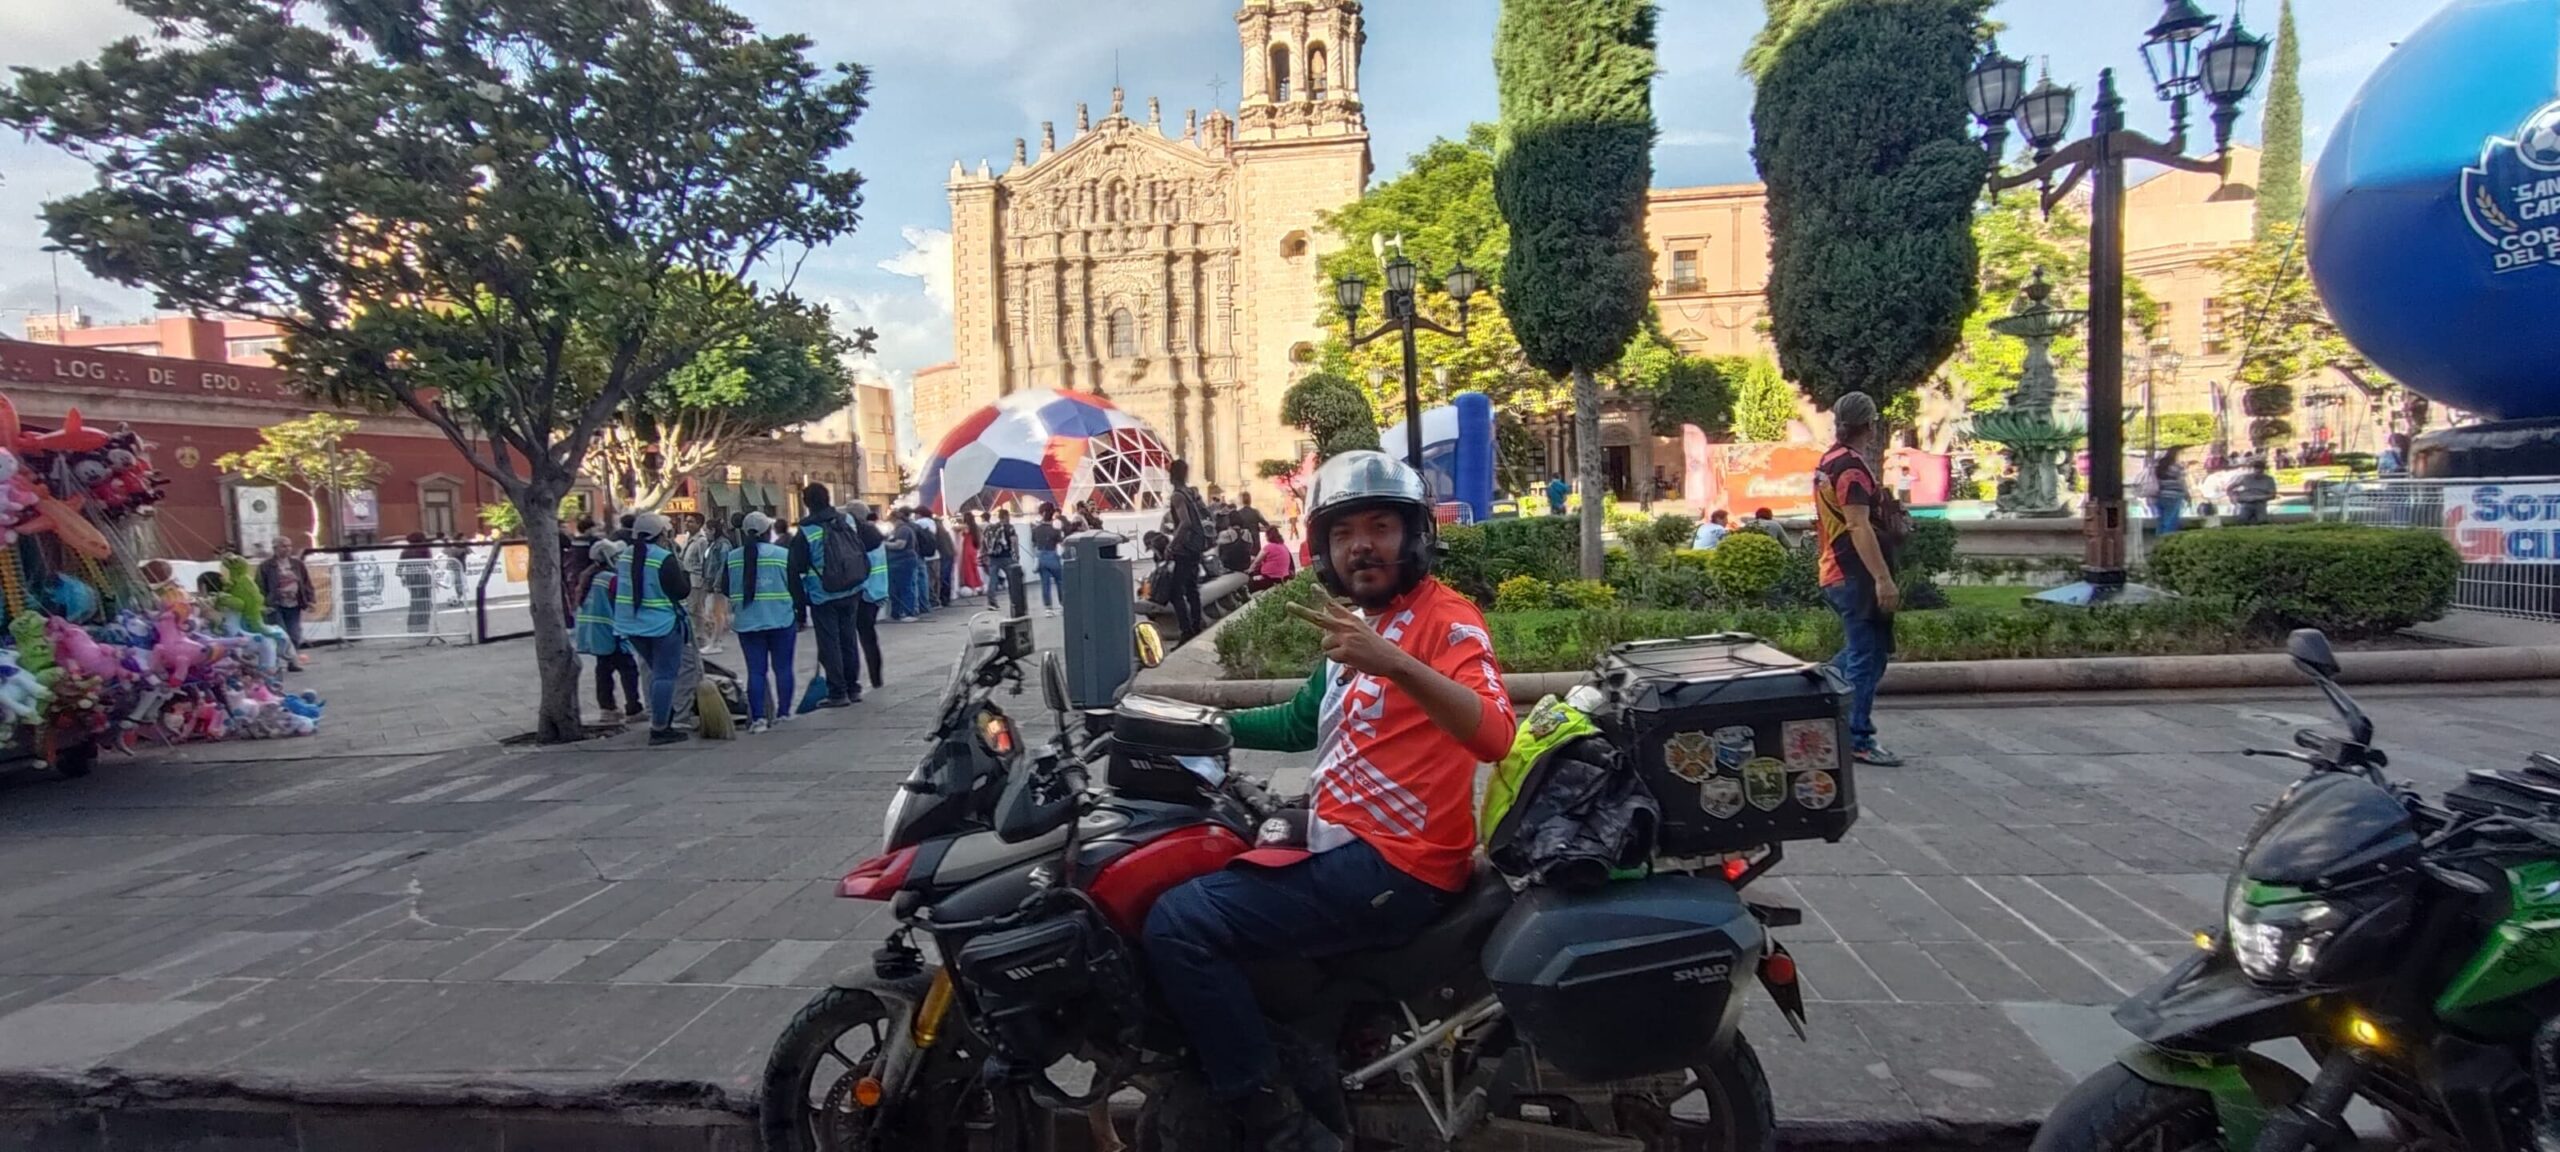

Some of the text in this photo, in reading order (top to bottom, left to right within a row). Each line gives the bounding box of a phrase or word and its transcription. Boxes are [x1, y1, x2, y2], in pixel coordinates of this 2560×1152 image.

[2500, 226, 2560, 251] COR
[2494, 247, 2544, 269] DEL
[54, 358, 241, 391] LOG DE EDO
[1672, 964, 1729, 981] SHAD
